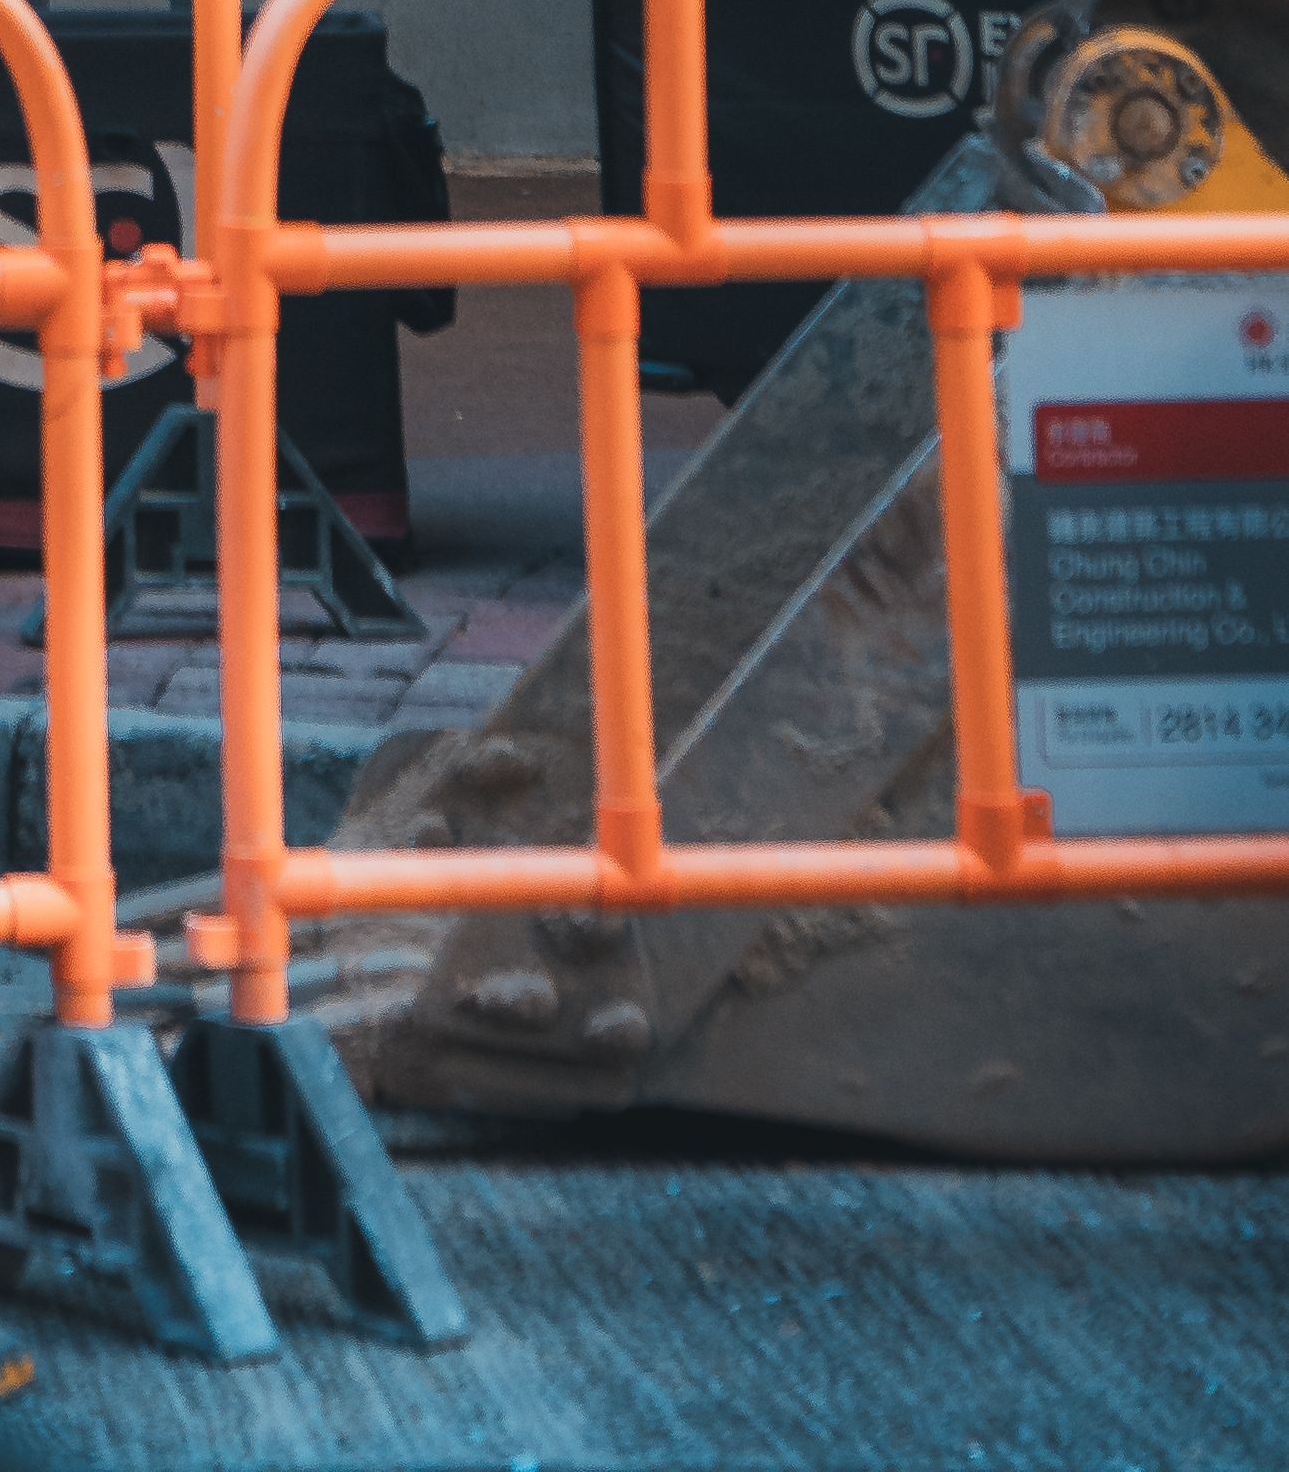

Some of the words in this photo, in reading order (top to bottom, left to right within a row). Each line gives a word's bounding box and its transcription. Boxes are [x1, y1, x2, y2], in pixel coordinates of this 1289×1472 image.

[1051, 582, 1221, 616] Construction
[1052, 615, 1210, 654] Engineering
[1159, 703, 1242, 744] 2814
